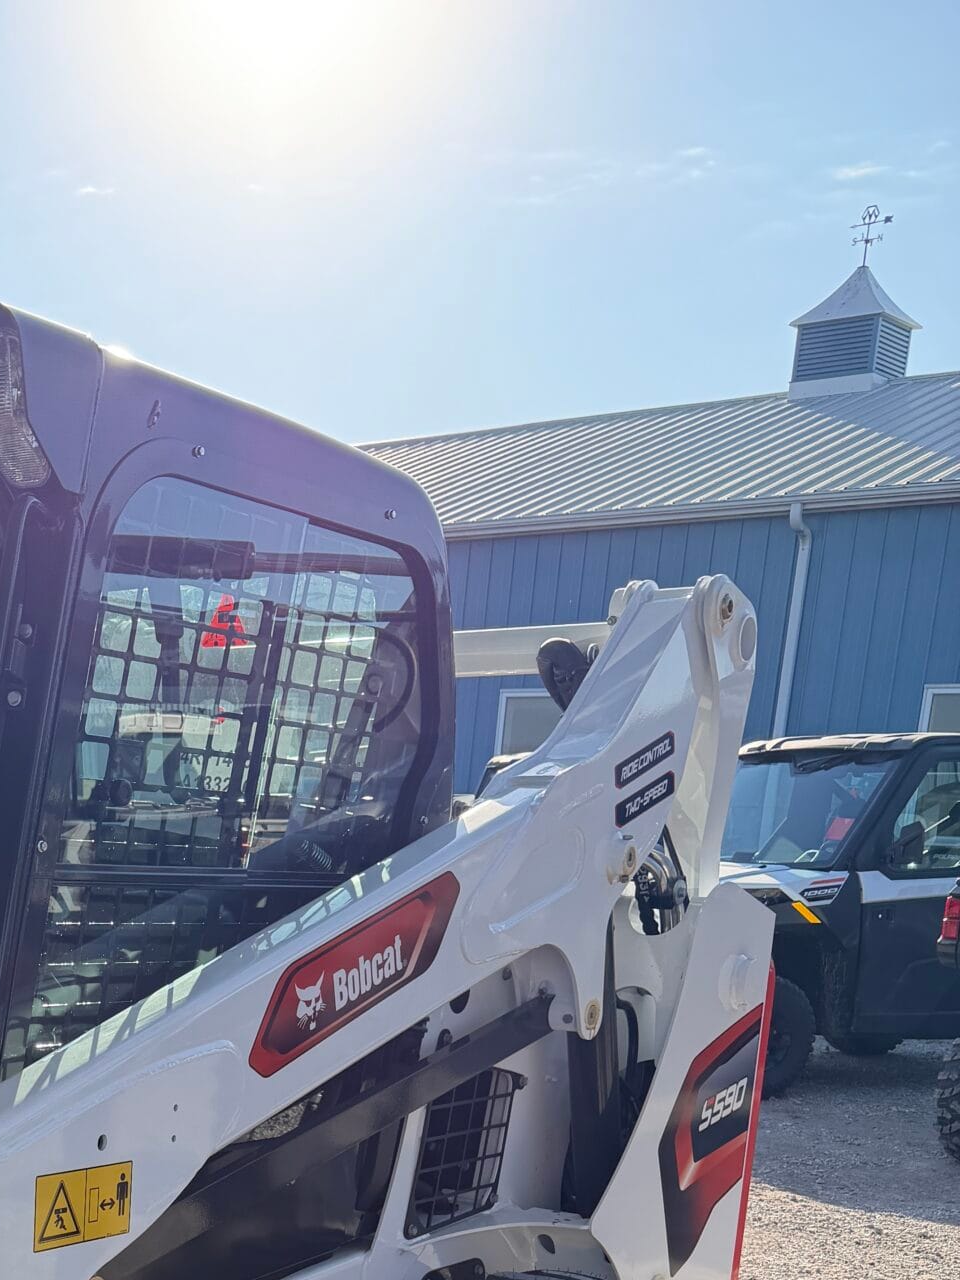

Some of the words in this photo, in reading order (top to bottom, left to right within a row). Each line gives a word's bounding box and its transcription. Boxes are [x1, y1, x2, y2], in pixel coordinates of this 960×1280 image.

[620, 757, 640, 782] RIDE
[639, 738, 672, 769] CONTROL
[625, 779, 669, 818] TWO-SPEED
[803, 887, 839, 897] 1000
[332, 934, 403, 1012] Bobcat
[698, 1076, 749, 1132] S590
